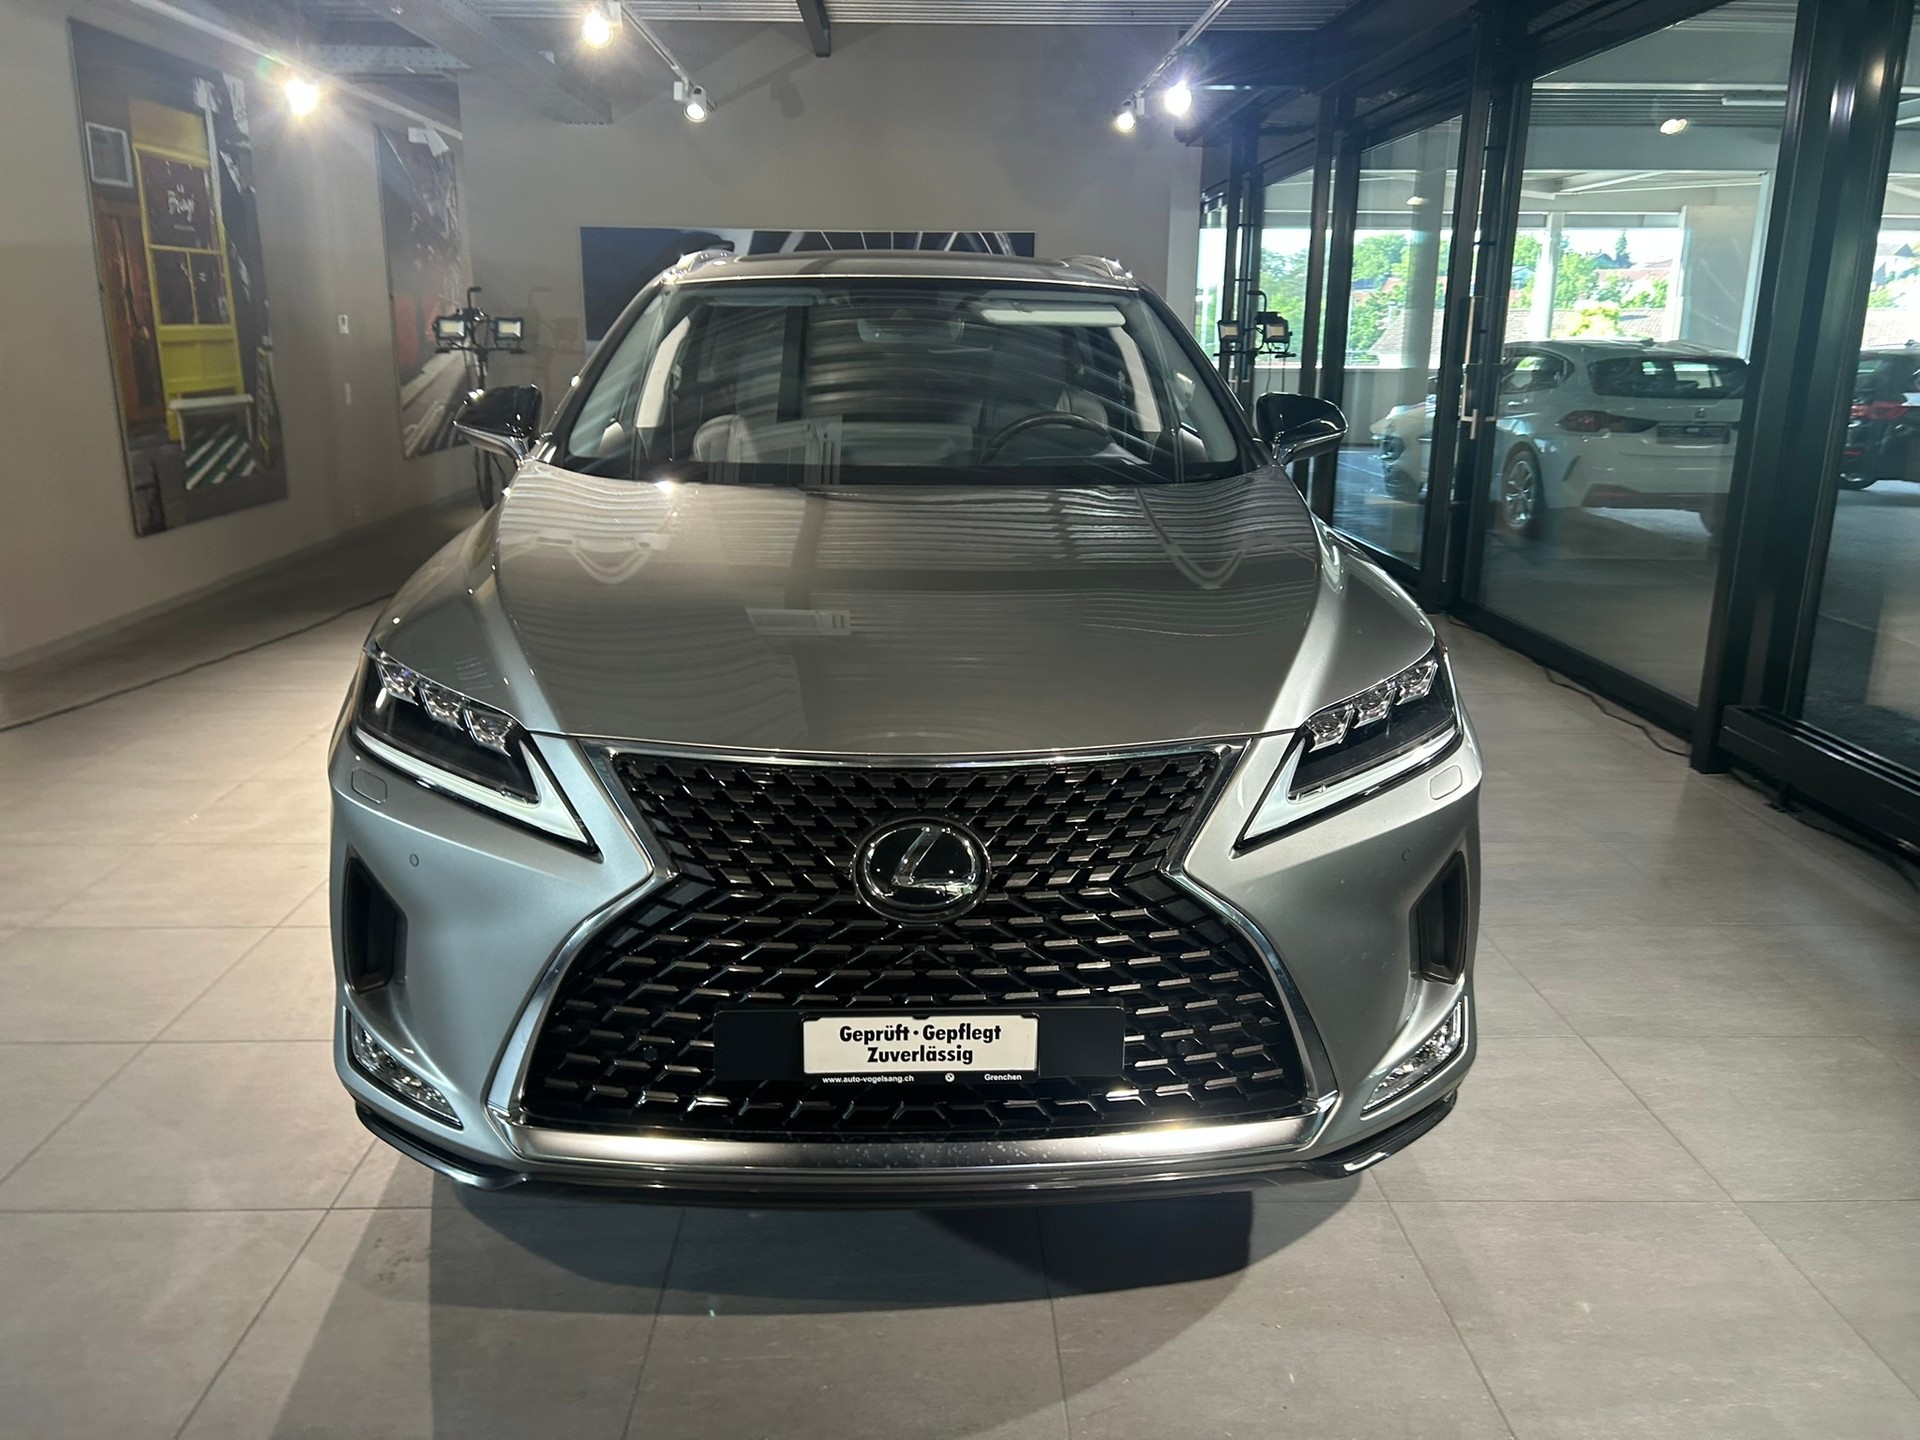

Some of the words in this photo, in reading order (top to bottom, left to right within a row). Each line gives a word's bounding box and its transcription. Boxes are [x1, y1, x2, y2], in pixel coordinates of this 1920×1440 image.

[839, 1023, 910, 1046] Geprüft
[922, 1022, 1002, 1045] Gepflegt
[867, 1044, 974, 1066] Zuverlässig
[821, 1074, 915, 1084] www.auto-vogelsang.ch
[983, 1072, 1023, 1082] Grenchen
